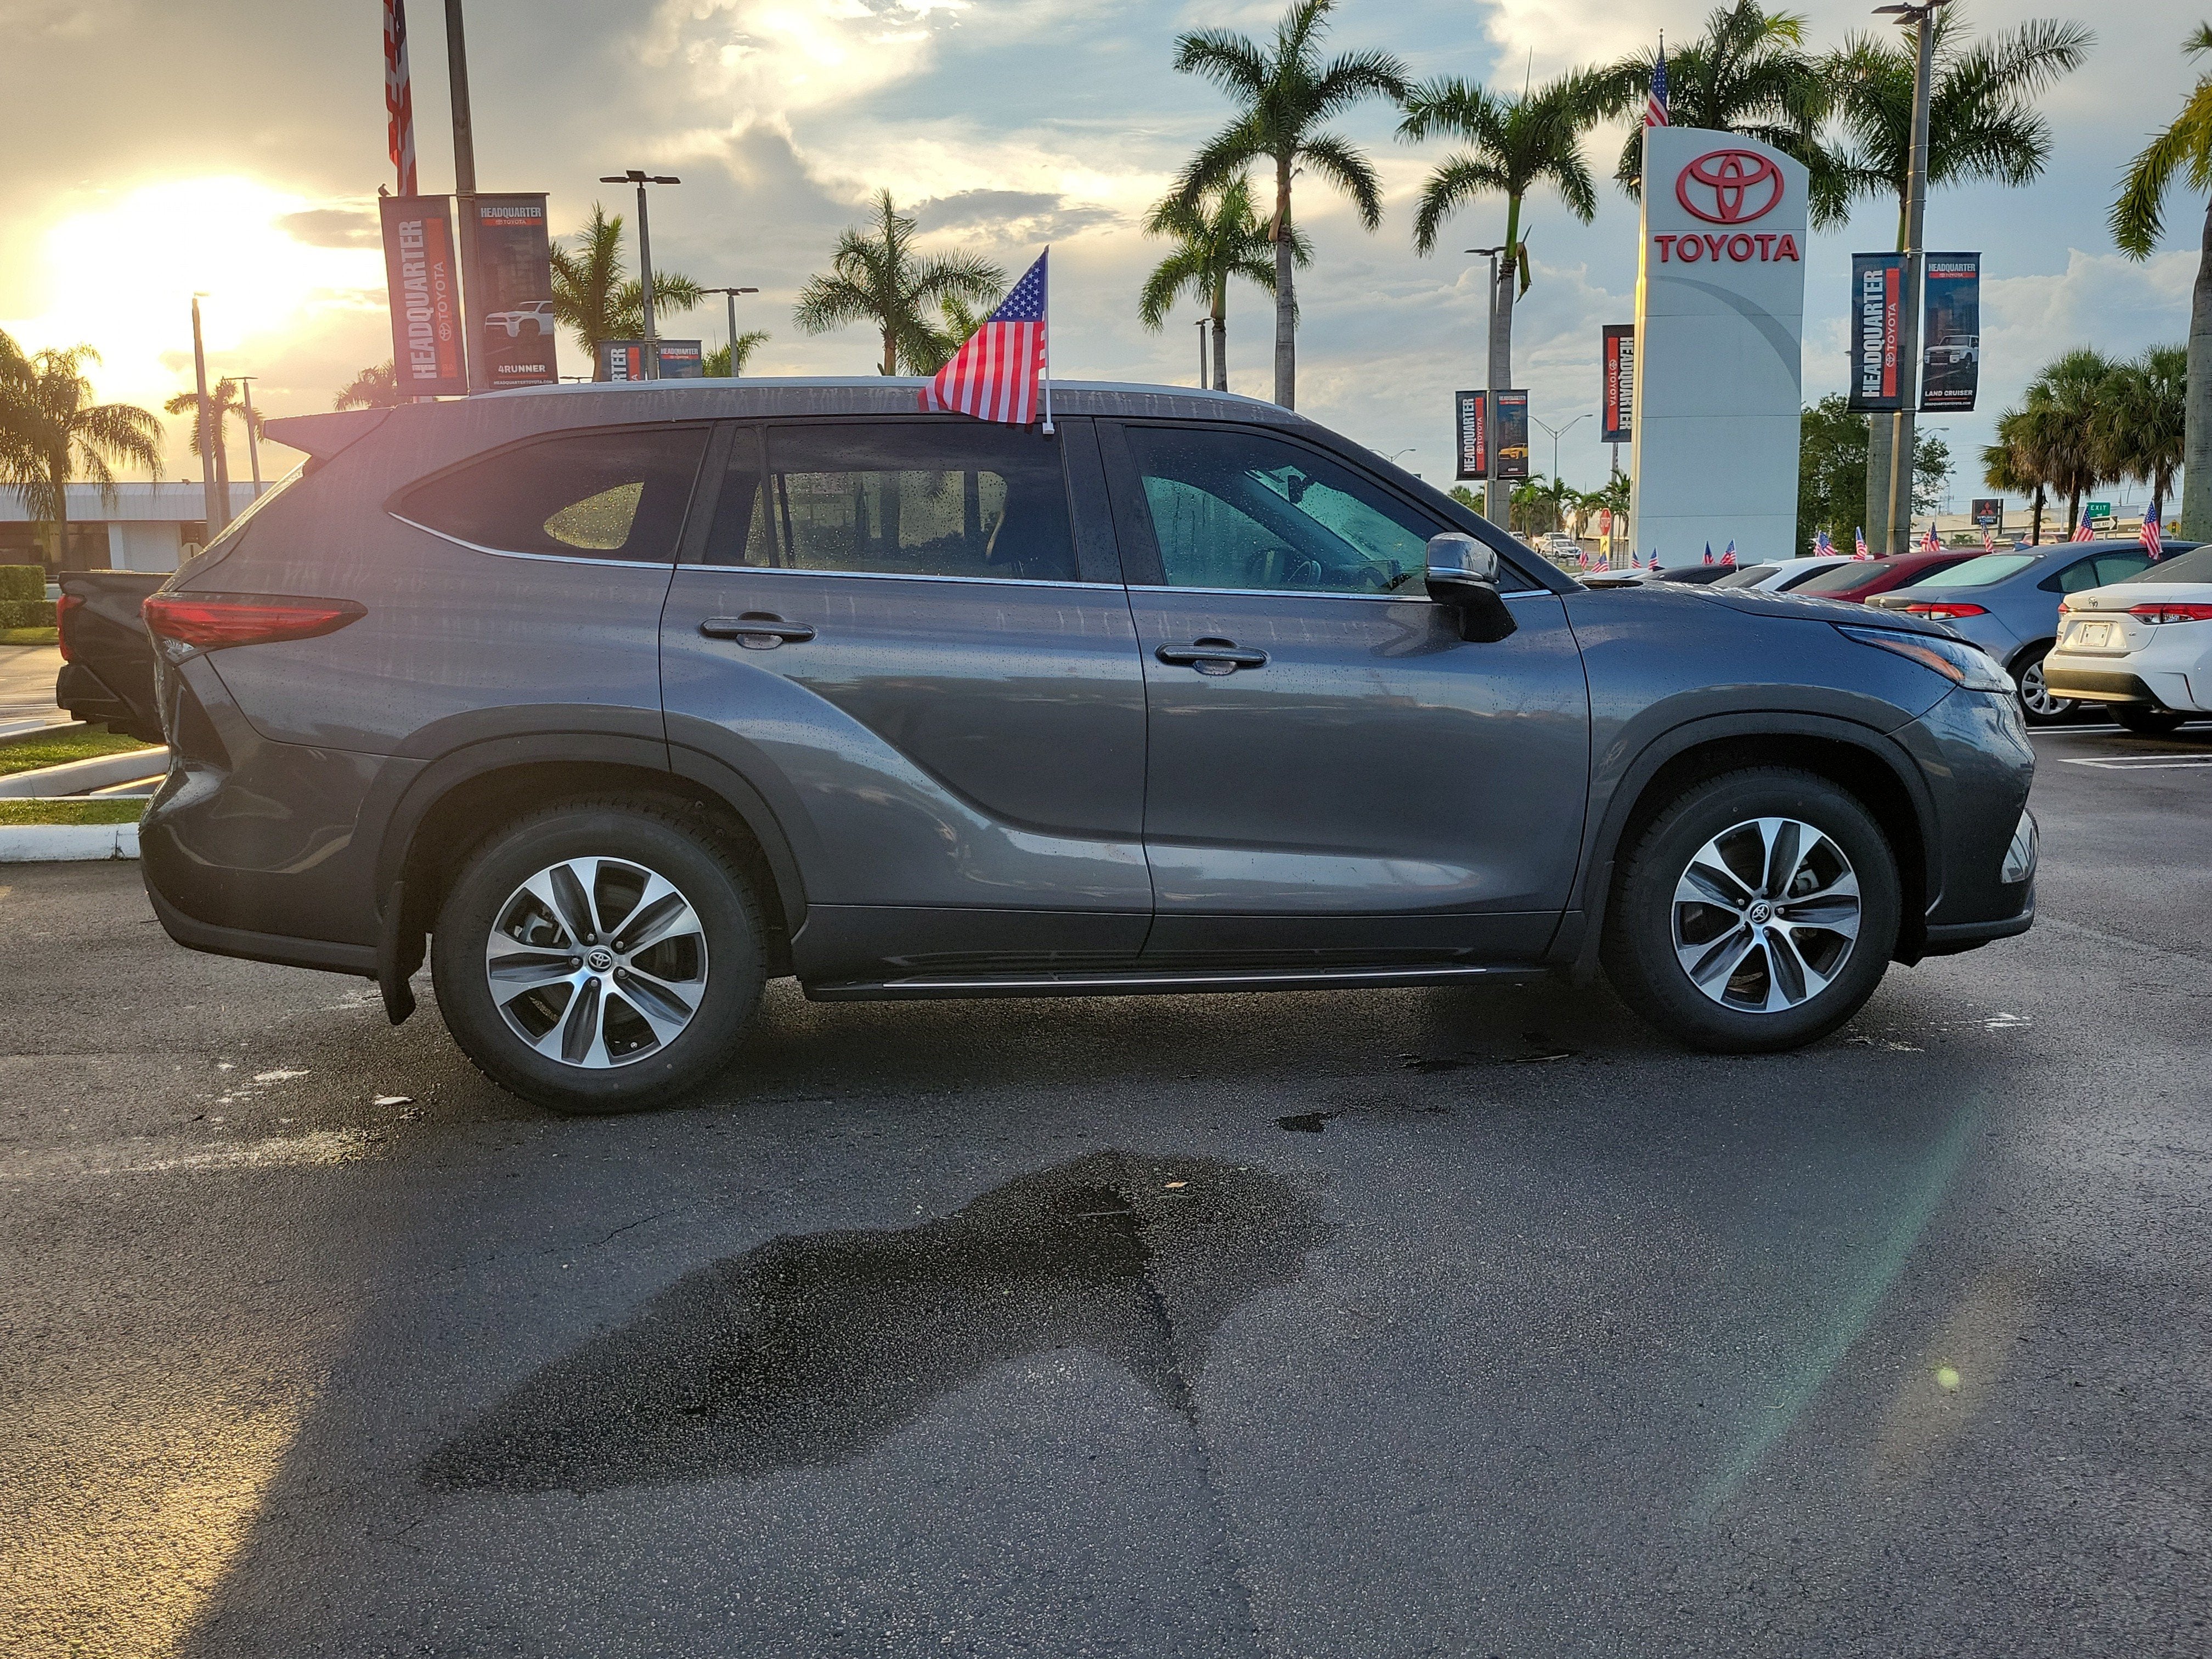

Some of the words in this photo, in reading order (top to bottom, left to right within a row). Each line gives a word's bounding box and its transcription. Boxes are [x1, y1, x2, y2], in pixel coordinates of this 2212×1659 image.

[481, 207, 541, 218] HEADQUARTER
[1654, 234, 1799, 262] TOYOTA
[1928, 263, 1975, 273] HEADQUARTER
[399, 220, 437, 379] HEADQUARTER
[433, 261, 447, 321] TOYOTA
[1862, 270, 1885, 397] HEADQUARTER
[1887, 303, 1896, 351] TOYOTA
[498, 365, 546, 373] 4RUNNER
[1620, 337, 1634, 430] HEADQUARTER
[1463, 398, 1476, 471] HEADQUARTER
